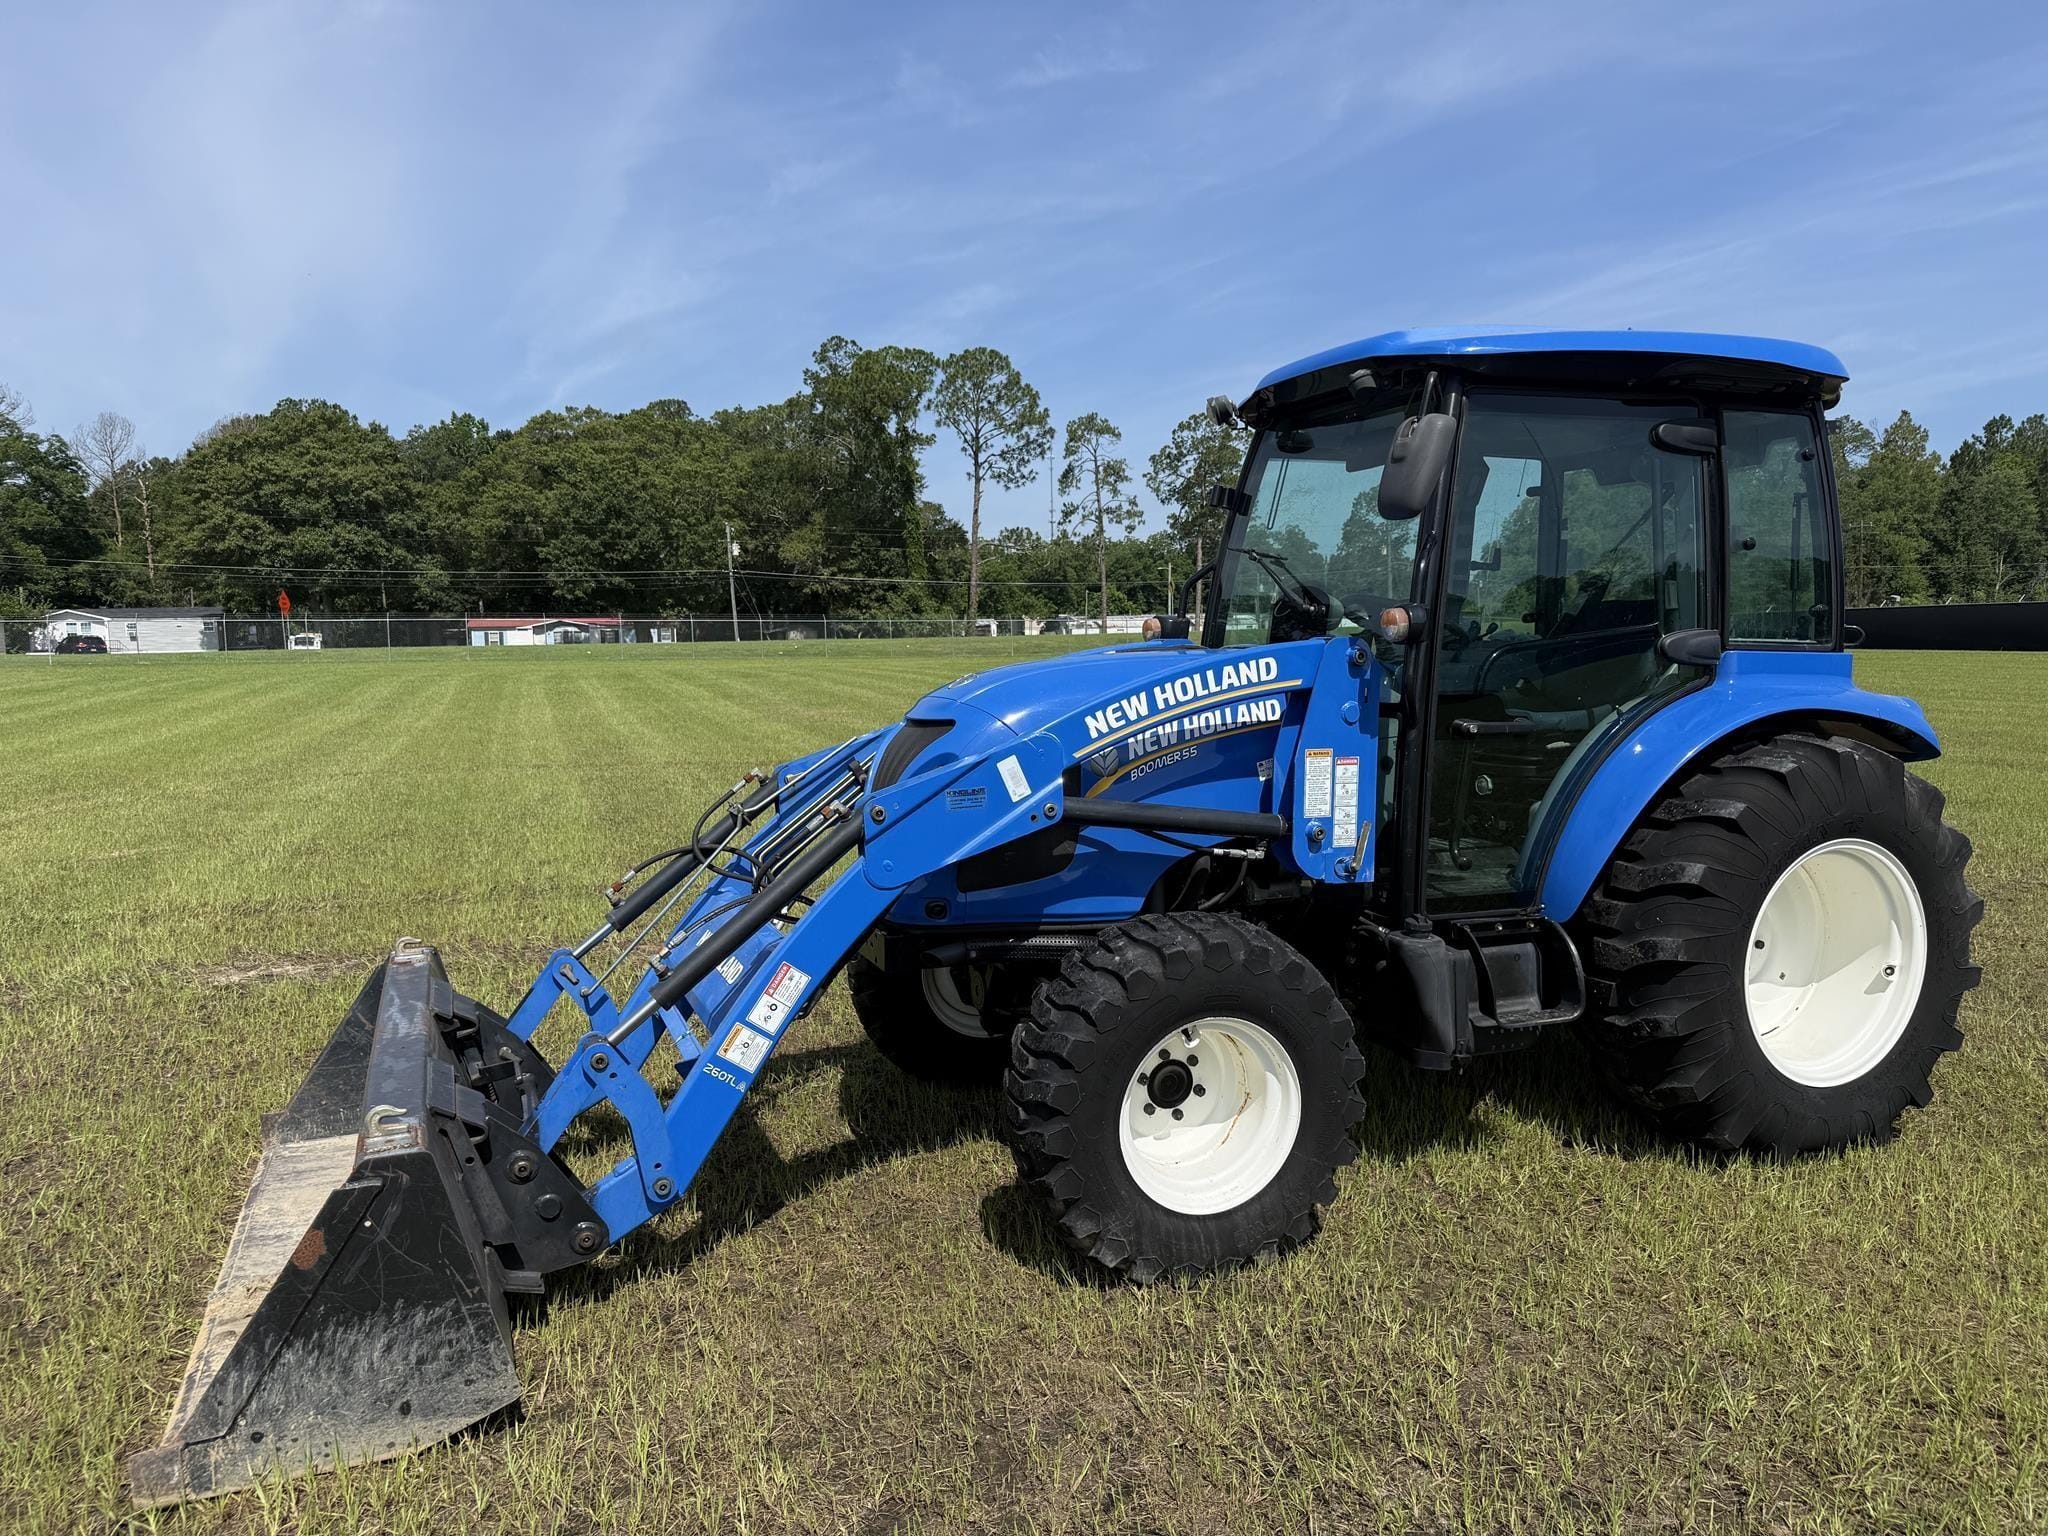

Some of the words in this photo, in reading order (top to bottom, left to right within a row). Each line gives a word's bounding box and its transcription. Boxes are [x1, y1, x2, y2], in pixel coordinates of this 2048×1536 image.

[1084, 691, 1149, 739] NEW
[1153, 656, 1278, 710] HOLLAND
[1127, 722, 1179, 761] NEW
[1184, 698, 1282, 740] HOLLAND
[1130, 752, 1181, 782] BOOMER
[1182, 745, 1198, 760] 55
[716, 956, 744, 985] LAND
[770, 965, 789, 990] DANGER
